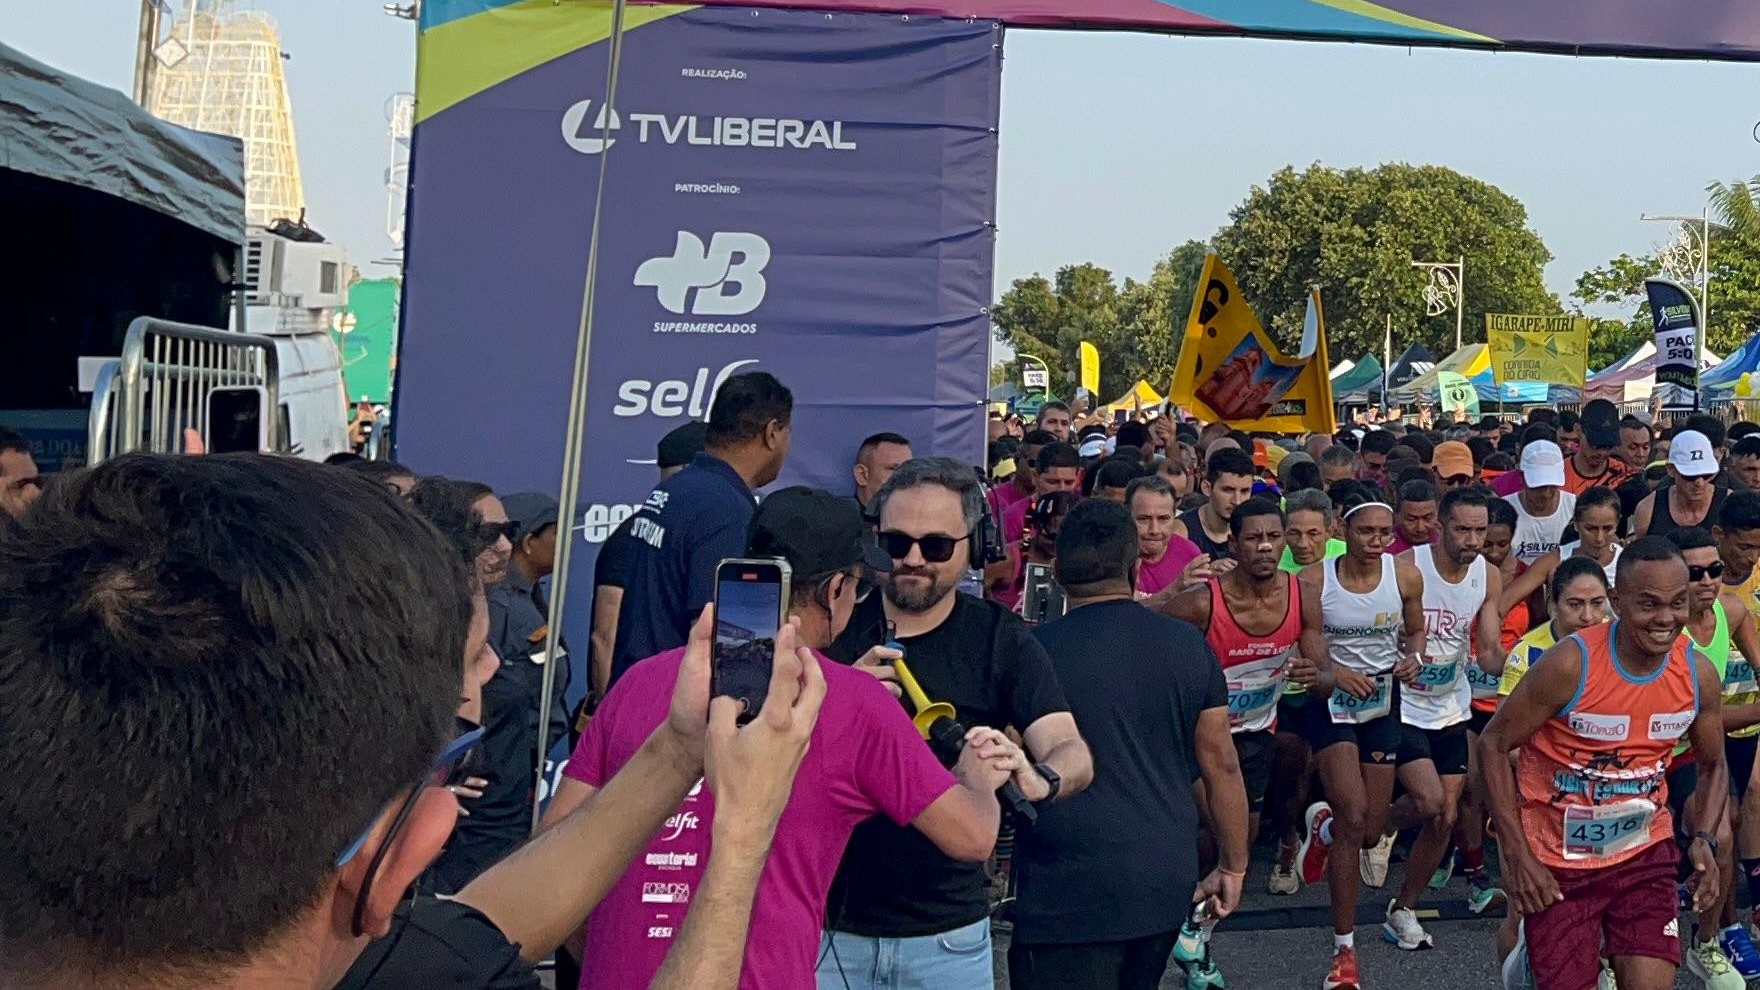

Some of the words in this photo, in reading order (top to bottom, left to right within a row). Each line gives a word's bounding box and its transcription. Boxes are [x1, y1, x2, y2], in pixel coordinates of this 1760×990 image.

[681, 66, 748, 81] REALIZAÇÃO:
[674, 181, 741, 195] PATROCÍNIO:
[652, 320, 757, 335] SUPERMERCADOS
[1666, 334, 1695, 348] PAC
[1667, 348, 1694, 360] 5:0
[1467, 669, 1499, 687] 843
[661, 811, 700, 842] elfit
